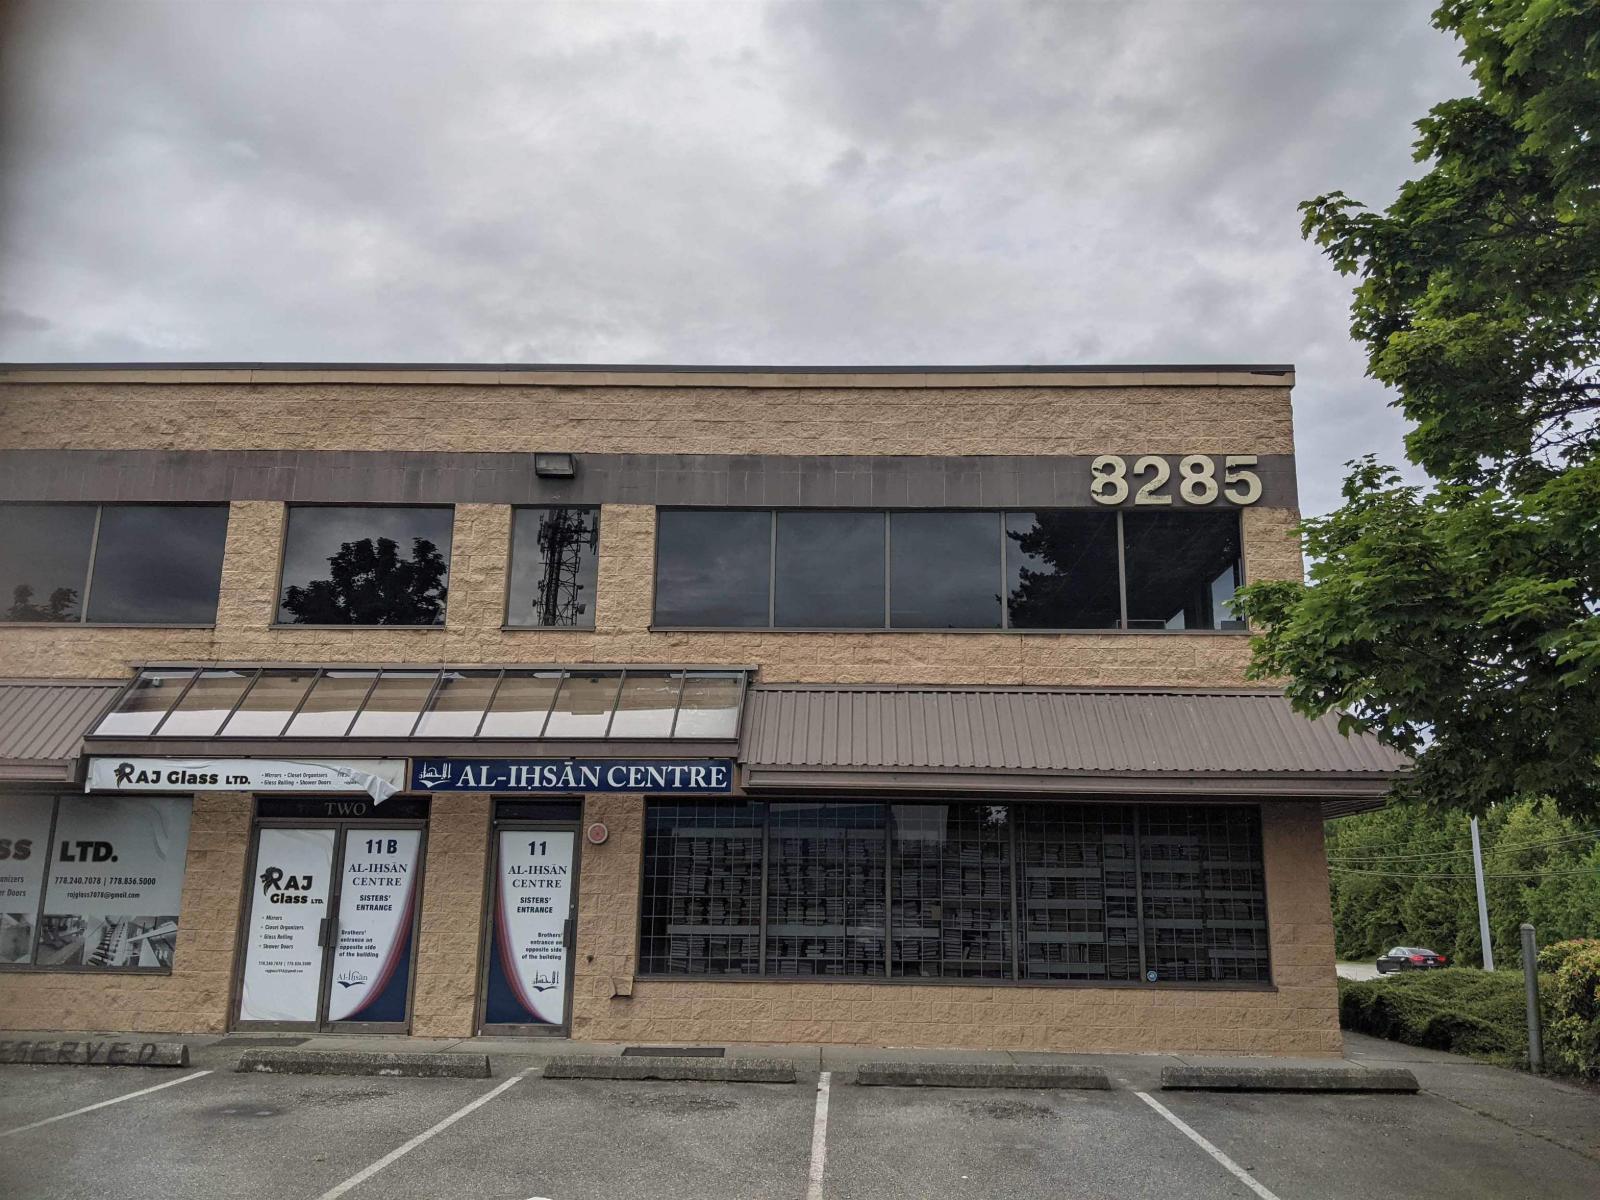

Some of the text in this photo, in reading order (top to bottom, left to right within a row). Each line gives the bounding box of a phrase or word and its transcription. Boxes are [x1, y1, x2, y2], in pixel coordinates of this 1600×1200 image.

[1090, 454, 1263, 505] 8285
[114, 762, 250, 788] RAJ Glass LTD.
[607, 766, 728, 788] CENTRE
[324, 803, 366, 816] TWO
[59, 841, 118, 863] LTD.
[528, 841, 547, 856] 11
[54, 877, 156, 885] 778.240.7078 778.836.5000
[260, 867, 313, 896] RAJ
[352, 877, 402, 886] CENTRE
[512, 879, 562, 888] CENTRE
[7, 889, 26, 897] Doors
[270, 893, 308, 904] Glass
